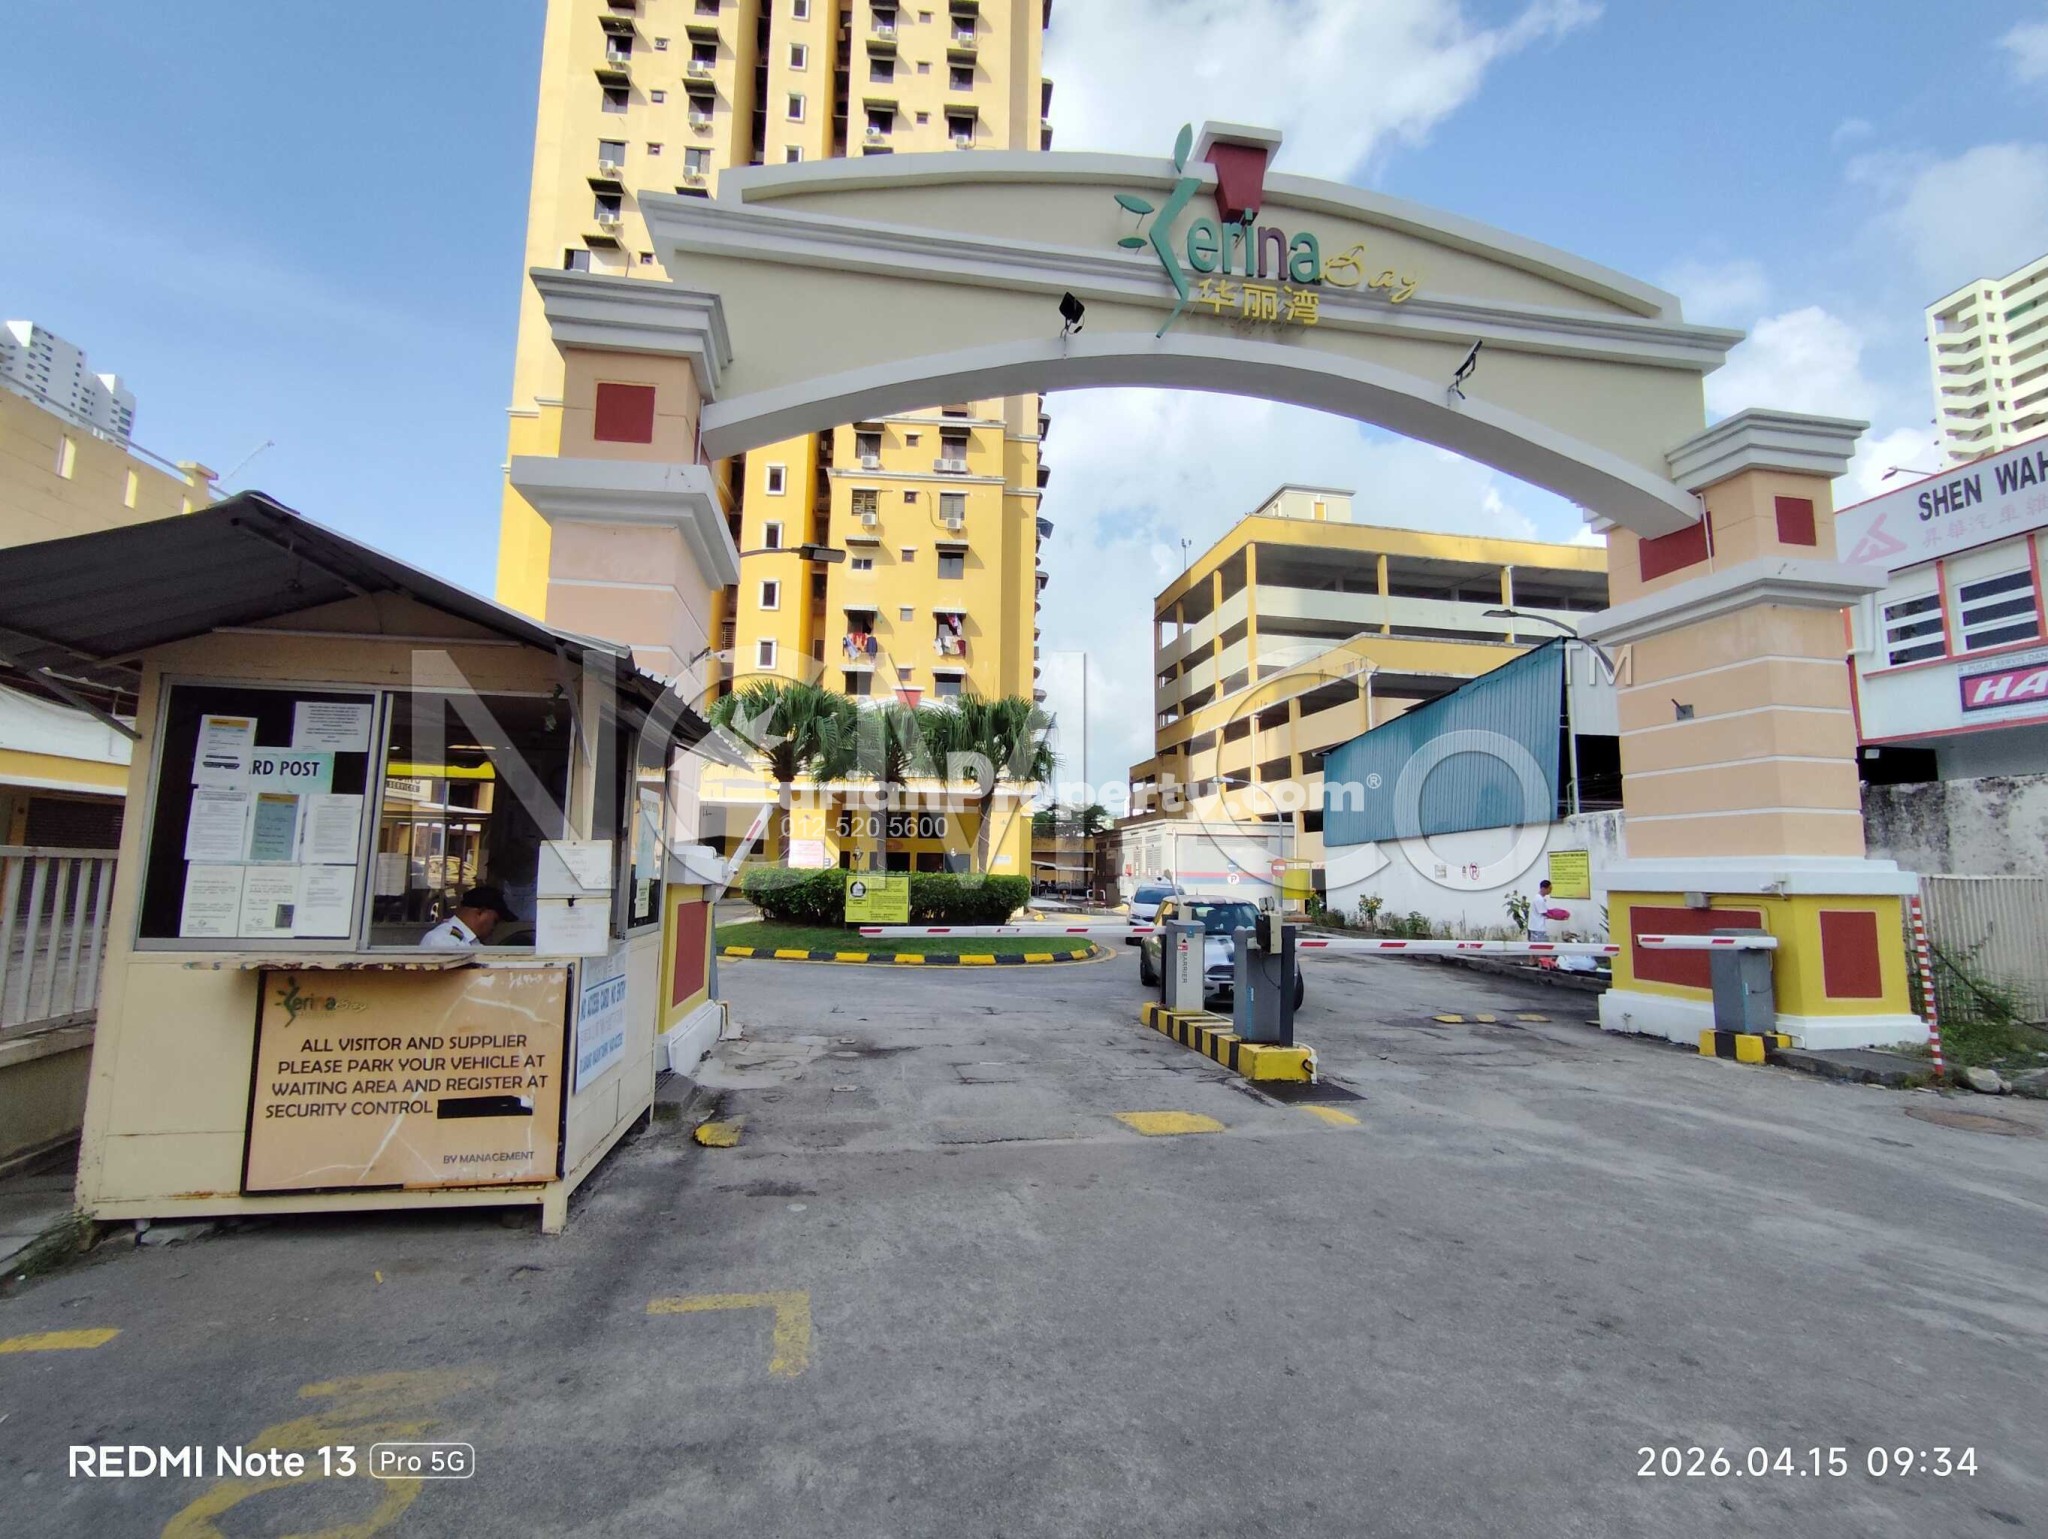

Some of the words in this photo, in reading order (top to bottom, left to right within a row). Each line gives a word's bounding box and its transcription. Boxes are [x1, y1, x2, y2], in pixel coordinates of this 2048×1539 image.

[1321, 242, 1425, 304] Bay
[1197, 277, 1321, 326] 华丽湾
[1918, 473, 1983, 521] SHEN
[279, 761, 320, 777] POST
[300, 1038, 333, 1053] ALL
[338, 1037, 402, 1052] VISITOR
[407, 1036, 444, 1050] AND
[449, 1034, 527, 1049] SUPPLIER
[277, 1059, 342, 1075] PLEASE
[347, 1058, 394, 1073] PARK
[398, 1057, 446, 1071] YOUR
[450, 1055, 520, 1070] VEHICLE
[523, 1054, 546, 1069] AT
[271, 1080, 348, 1097] WAITING
[352, 1079, 398, 1094] AREA
[402, 1078, 442, 1093] AND
[446, 1075, 523, 1091] REGISTER
[526, 1074, 549, 1089] AT
[265, 1102, 347, 1119] SECURITY
[351, 1100, 434, 1116] CONTROL
[443, 1154, 457, 1165] BY
[459, 1151, 535, 1164] MANAGEMENT
